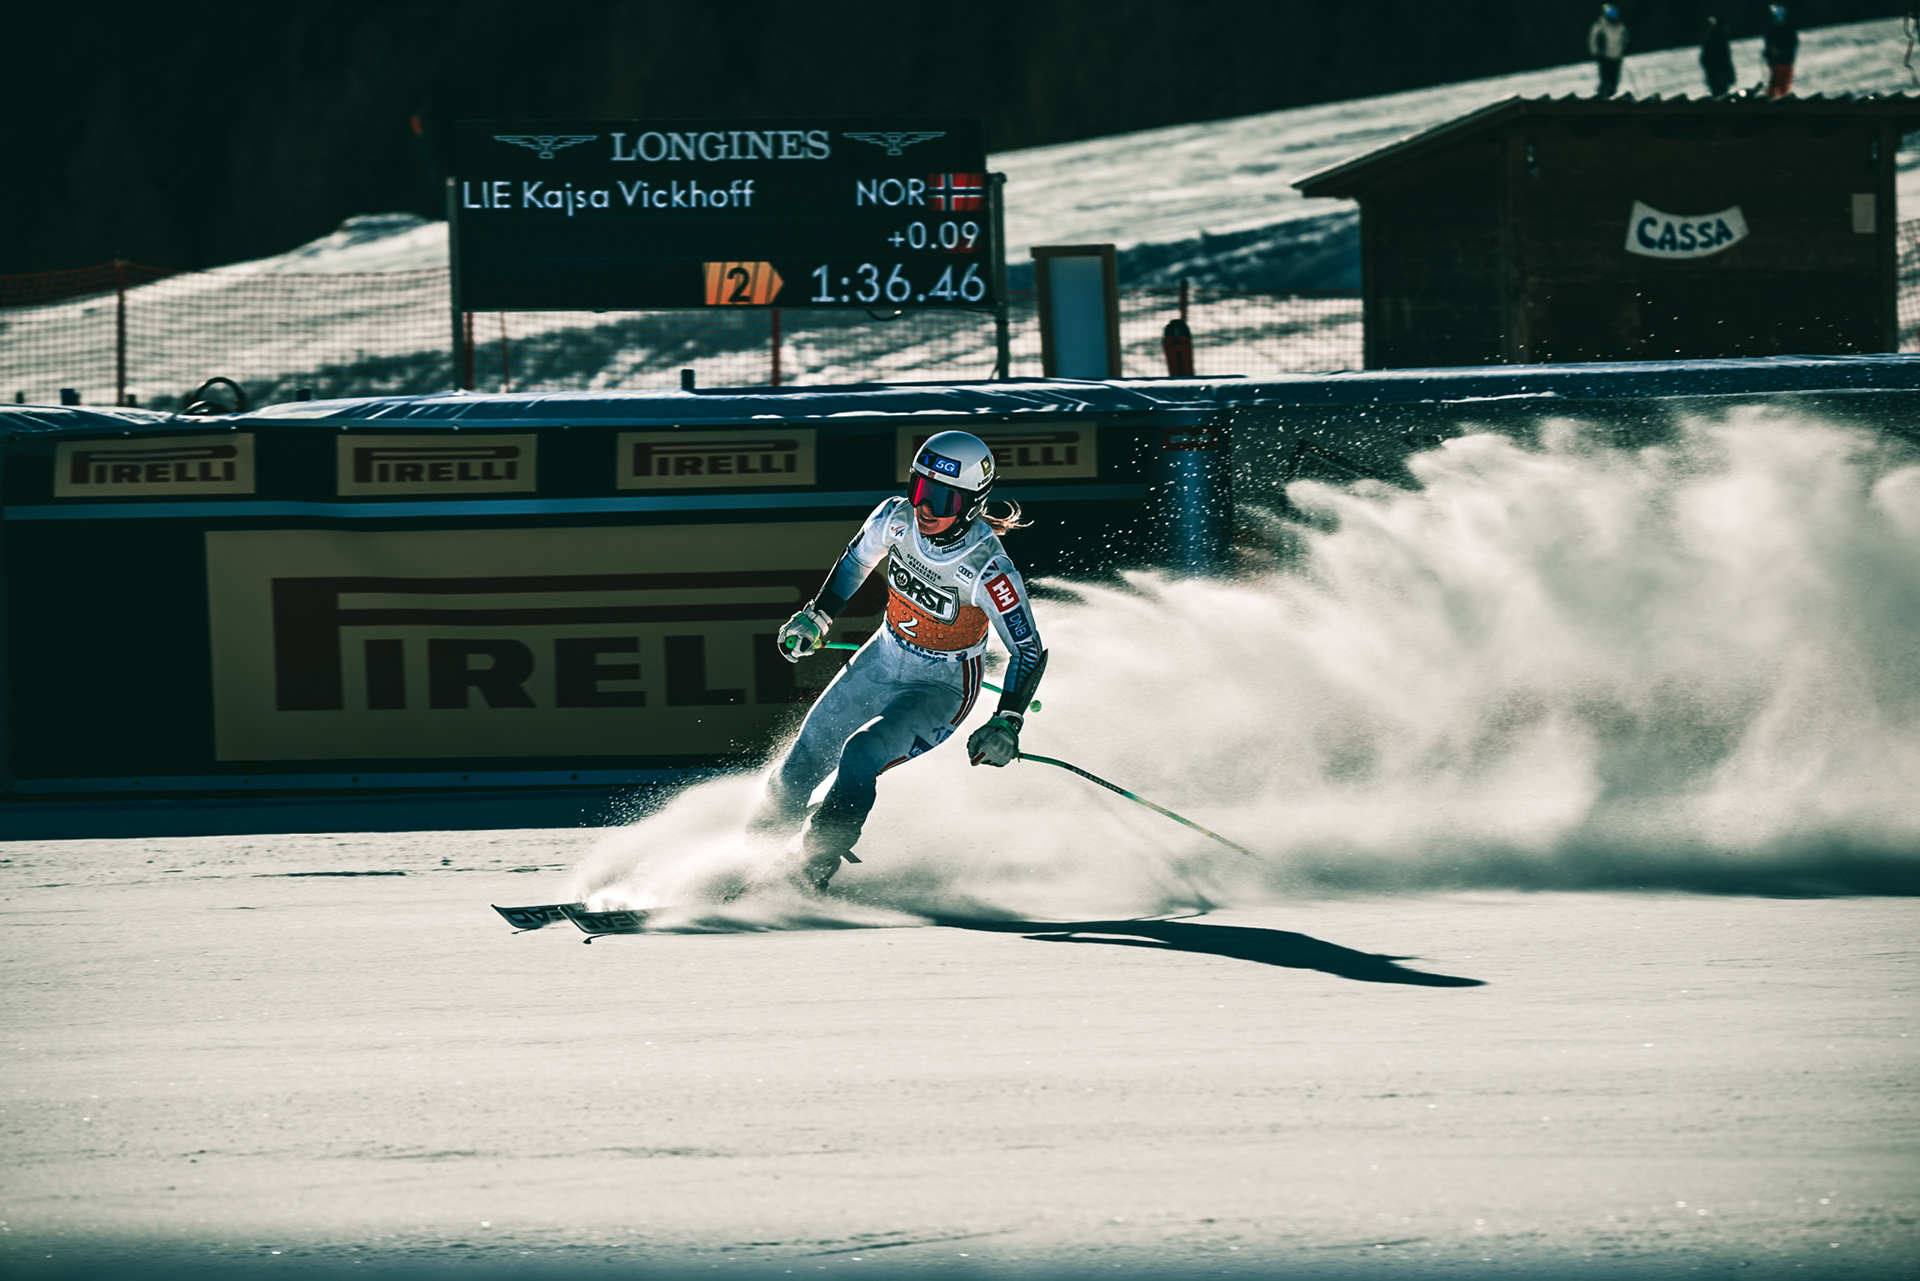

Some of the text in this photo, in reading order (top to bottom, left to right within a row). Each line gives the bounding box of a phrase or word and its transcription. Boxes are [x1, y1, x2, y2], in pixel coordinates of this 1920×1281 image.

[610, 129, 832, 162] LONGINES
[463, 177, 926, 217] LIE Kajsa Vickhoff NOR
[887, 220, 980, 250] +0.09
[1637, 216, 1733, 251] CASSA
[726, 262, 986, 303] 2 1:36.46
[70, 444, 238, 485] PIRELLI
[353, 445, 521, 484] PIRELLI
[633, 438, 799, 477] PIRELLI
[935, 459, 956, 473] 5G
[889, 557, 953, 615] FORST
[897, 616, 918, 639] 2
[1008, 612, 1028, 638] DNB
